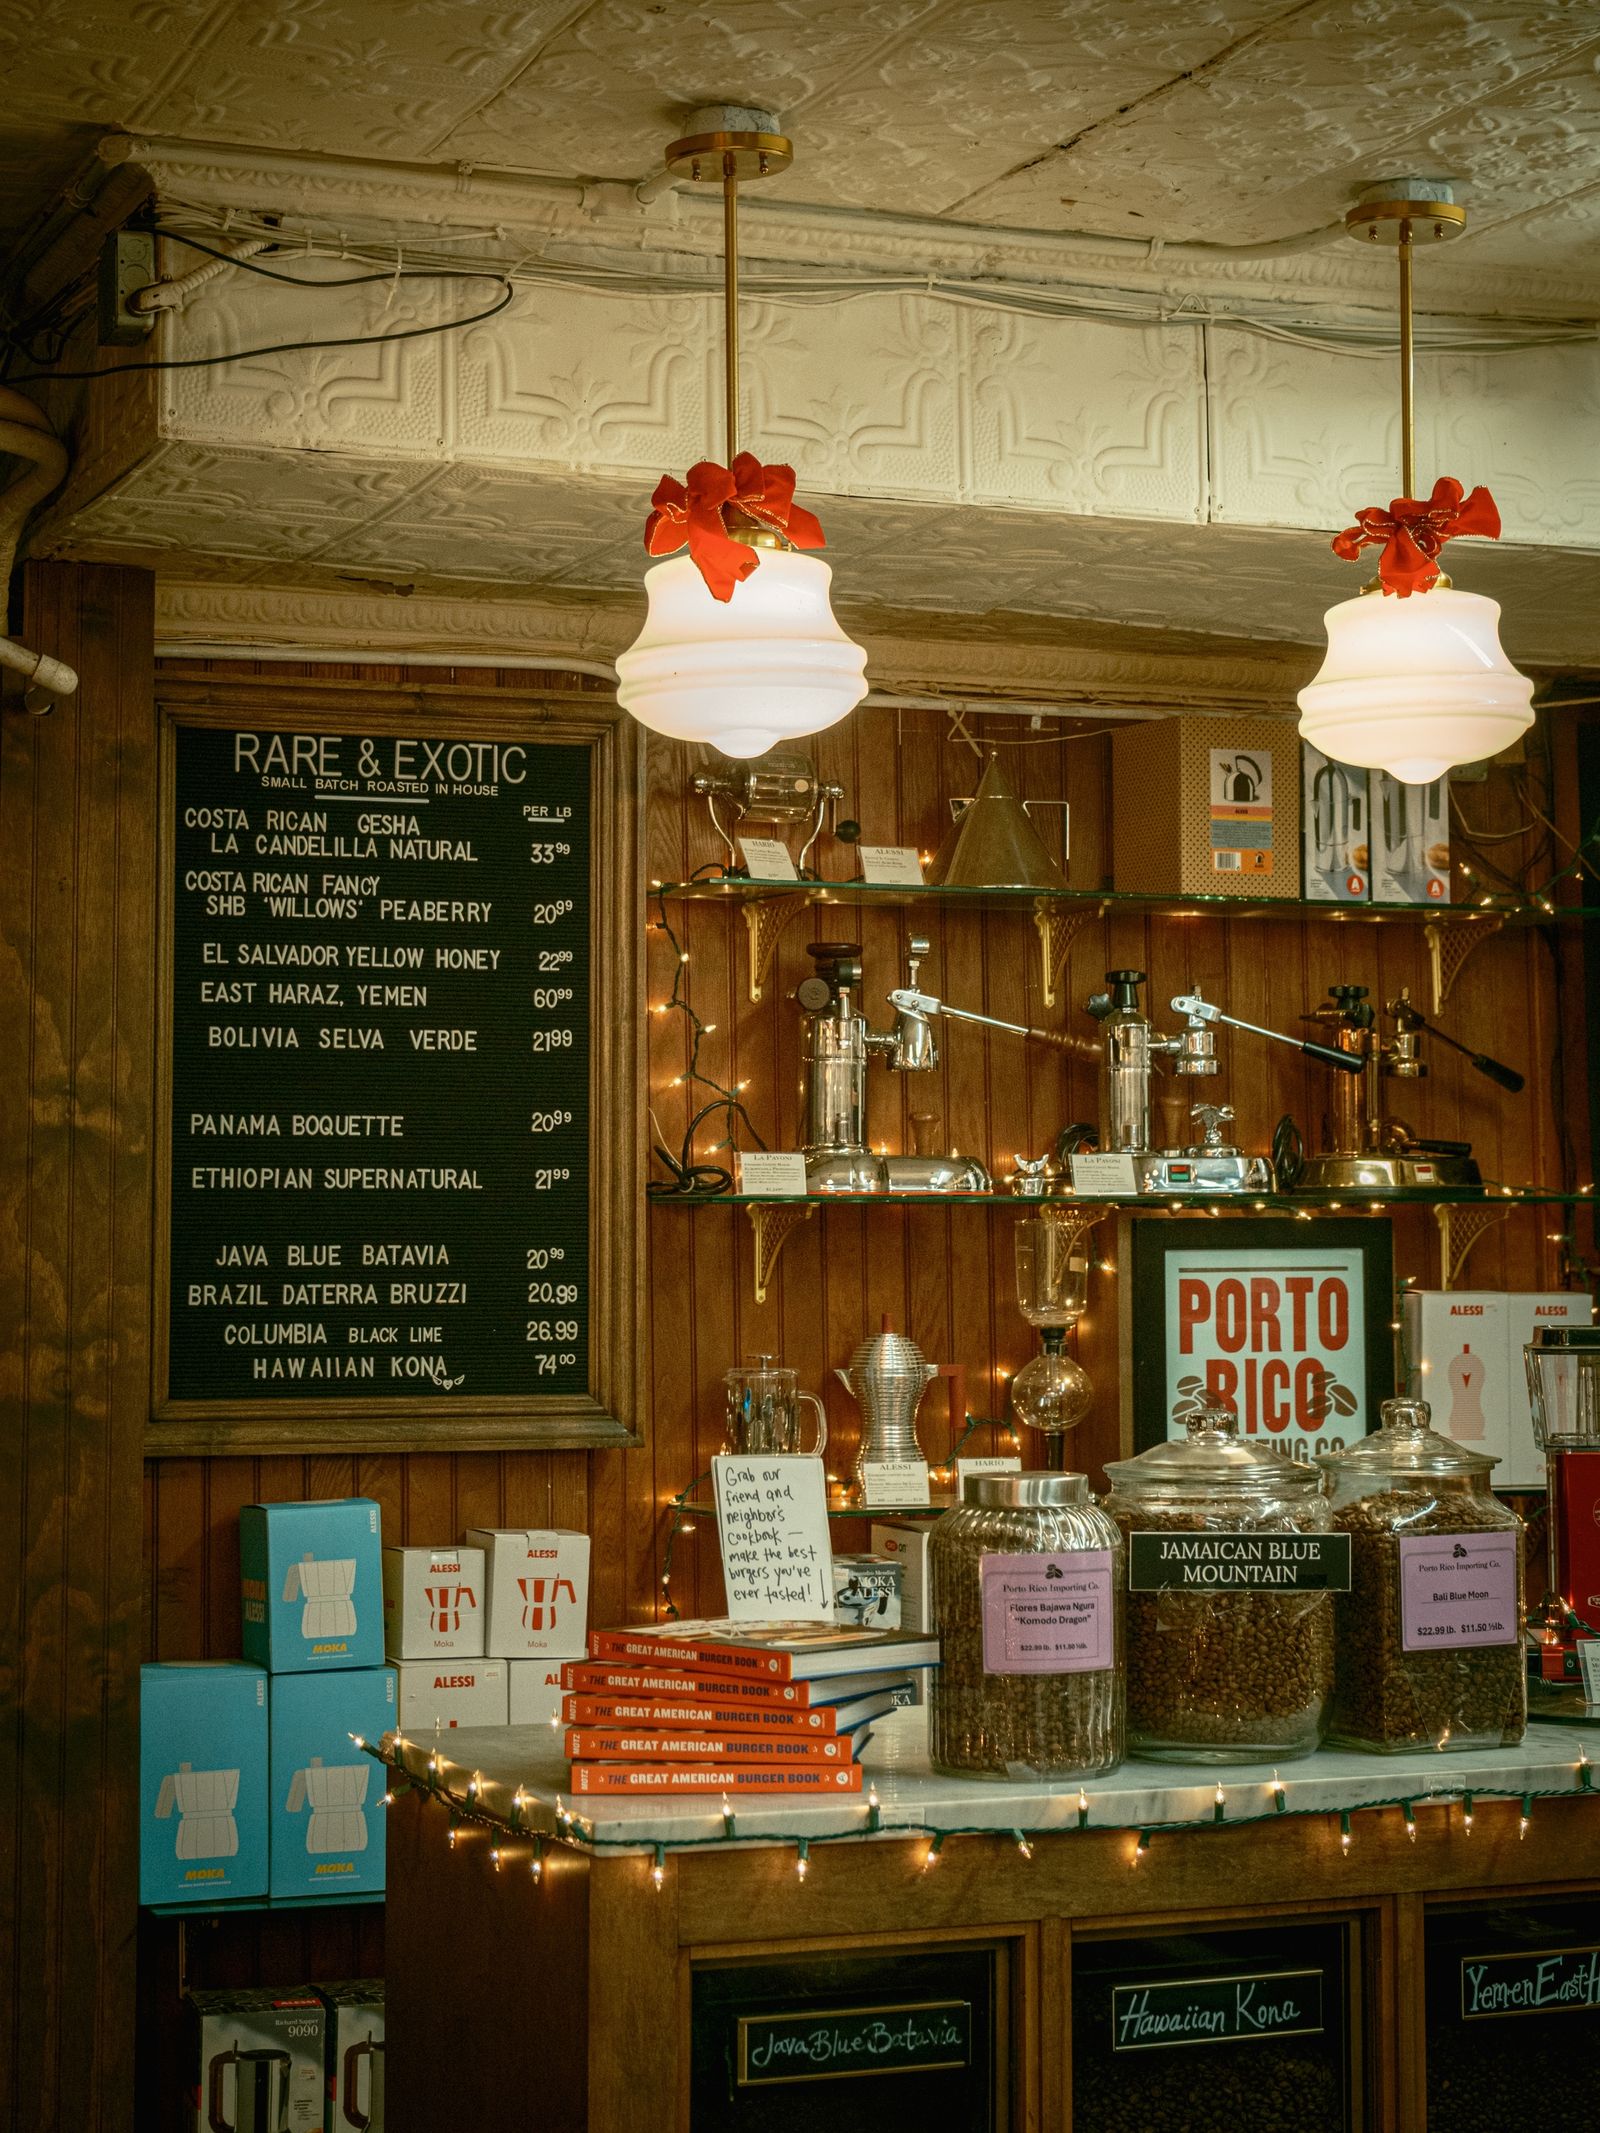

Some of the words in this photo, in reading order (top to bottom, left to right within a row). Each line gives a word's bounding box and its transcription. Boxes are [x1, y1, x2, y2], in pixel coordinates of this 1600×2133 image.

[234, 733, 342, 776] RARE
[358, 739, 380, 778] &
[394, 741, 527, 784] EXOTIC
[261, 776, 307, 789] SMALL
[315, 778, 358, 791] BATCH
[367, 780, 429, 793] ROASTED
[435, 783, 448, 794] IN
[452, 783, 499, 796] HOUSE
[523, 806, 548, 816] PER
[556, 807, 571, 817] LB
[185, 809, 249, 830] COSTA
[267, 811, 327, 832] RICAN
[358, 814, 419, 835] GESHA
[211, 834, 238, 854] LA
[256, 835, 377, 858] CANDELILLA
[390, 839, 478, 861] NATURAL
[186, 872, 246, 893] COSTA
[253, 873, 308, 893] RICAN
[323, 875, 380, 896] FANCY
[206, 896, 245, 916] SHB
[380, 901, 491, 923] PEABERRY
[203, 944, 228, 964] EL
[238, 944, 339, 967] SALVADOR
[346, 946, 423, 968] YELLOW
[436, 949, 500, 969] HONEY
[201, 983, 257, 1003] EAST
[269, 984, 344, 1007] HARAZ,
[357, 986, 427, 1007] YEMEN
[209, 1027, 299, 1048] BOLIVIA
[319, 1028, 384, 1049] SELVA
[410, 1030, 477, 1051] VERDE
[191, 1114, 280, 1136] PANAMA
[293, 1115, 404, 1136] BOQUETTE
[192, 1168, 312, 1189] ETHIOPIAN
[324, 1169, 482, 1189] SUPERNATURAL
[216, 1245, 268, 1266] JAVA
[288, 1245, 340, 1266] BLUE
[362, 1245, 449, 1265] BATAVIA
[188, 1284, 268, 1306] BRAZIL
[283, 1284, 378, 1305] DATERRA
[390, 1283, 467, 1304] BRUZZI
[528, 1283, 577, 1304] 20.99
[1179, 1277, 1349, 1354] PORTO
[1450, 1306, 1483, 1315] ALESSI
[1535, 1306, 1568, 1316] ALESSI
[225, 1324, 327, 1345] COLUMBIA
[349, 1327, 398, 1344] BLACK
[410, 1326, 442, 1343] LIME
[526, 1322, 578, 1341] 26.99
[254, 1357, 374, 1379] HAWAIIAN
[391, 1357, 447, 1377] KONA
[1206, 1357, 1325, 1434] RICO
[726, 1467, 755, 1486] Grab
[763, 1468, 781, 1480] our
[726, 1490, 760, 1506] friend
[767, 1485, 794, 1501] and
[727, 1505, 784, 1529] neighbor's
[527, 1550, 557, 1558] ALESSI
[729, 1550, 759, 1562] make
[764, 1548, 782, 1562] the
[788, 1545, 817, 1561] best
[1160, 1542, 1262, 1559] JAMAICAN
[1269, 1543, 1321, 1559] BLUE
[430, 1564, 460, 1573] ALESSI
[729, 1567, 769, 1584] burgers
[774, 1565, 811, 1586] you've
[1183, 1565, 1297, 1583] MOUNTAIN
[1457, 1562, 1488, 1571] Importing
[858, 1576, 895, 1587] MOKA
[1003, 1584, 1026, 1592] Porto
[1050, 1583, 1086, 1592] Importing
[734, 1588, 759, 1600] ever
[764, 1583, 812, 1604] tasted!
[854, 1587, 895, 1597] ALESSI
[1433, 1593, 1448, 1601] Bali
[1450, 1592, 1466, 1600] Blue
[1468, 1591, 1488, 1599] Moon
[1010, 1604, 1038, 1612] Flores
[1040, 1604, 1070, 1612] Bajawa
[1073, 1602, 1094, 1611] Ngura
[1418, 1626, 1444, 1635] $22.99
[1461, 1624, 1486, 1633] $11.50
[313, 1643, 347, 1654] MOKA
[611, 1643, 625, 1652] THE
[627, 1643, 653, 1656] GREAT
[654, 1647, 697, 1661] AMERICAN
[699, 1653, 732, 1665] BURGER
[735, 1658, 758, 1668] BOOK
[434, 1676, 474, 1689] ALESSI
[589, 1675, 605, 1684] THE
[608, 1676, 640, 1688] GREAT
[643, 1678, 695, 1691] AMERICAN
[698, 1683, 738, 1694] BURGER
[742, 1685, 769, 1696] BOOK
[595, 1707, 612, 1716] THE
[615, 1707, 650, 1718] GREAT
[653, 1709, 712, 1720] AMERICAN
[716, 1712, 760, 1722] BURGER
[763, 1714, 794, 1724] BOOK
[599, 1741, 618, 1749] THE
[621, 1740, 658, 1750] GREAT
[662, 1741, 723, 1753] AMERICAN
[727, 1743, 773, 1753] BURGER
[778, 1744, 808, 1754] BOOK
[608, 1775, 627, 1784] THE
[630, 1773, 668, 1784] GREAT
[672, 1773, 734, 1784] AMERICAN
[738, 1773, 784, 1783] BURGER
[788, 1773, 820, 1783] BOOK
[185, 1869, 224, 1880] MOKA
[316, 1862, 354, 1874] MOKA
[1466, 1965, 1536, 2011] Yemen
[1120, 1990, 1224, 2042] Hawaiian
[1237, 1983, 1300, 2031] Kona
[288, 2025, 318, 2037] 9090
